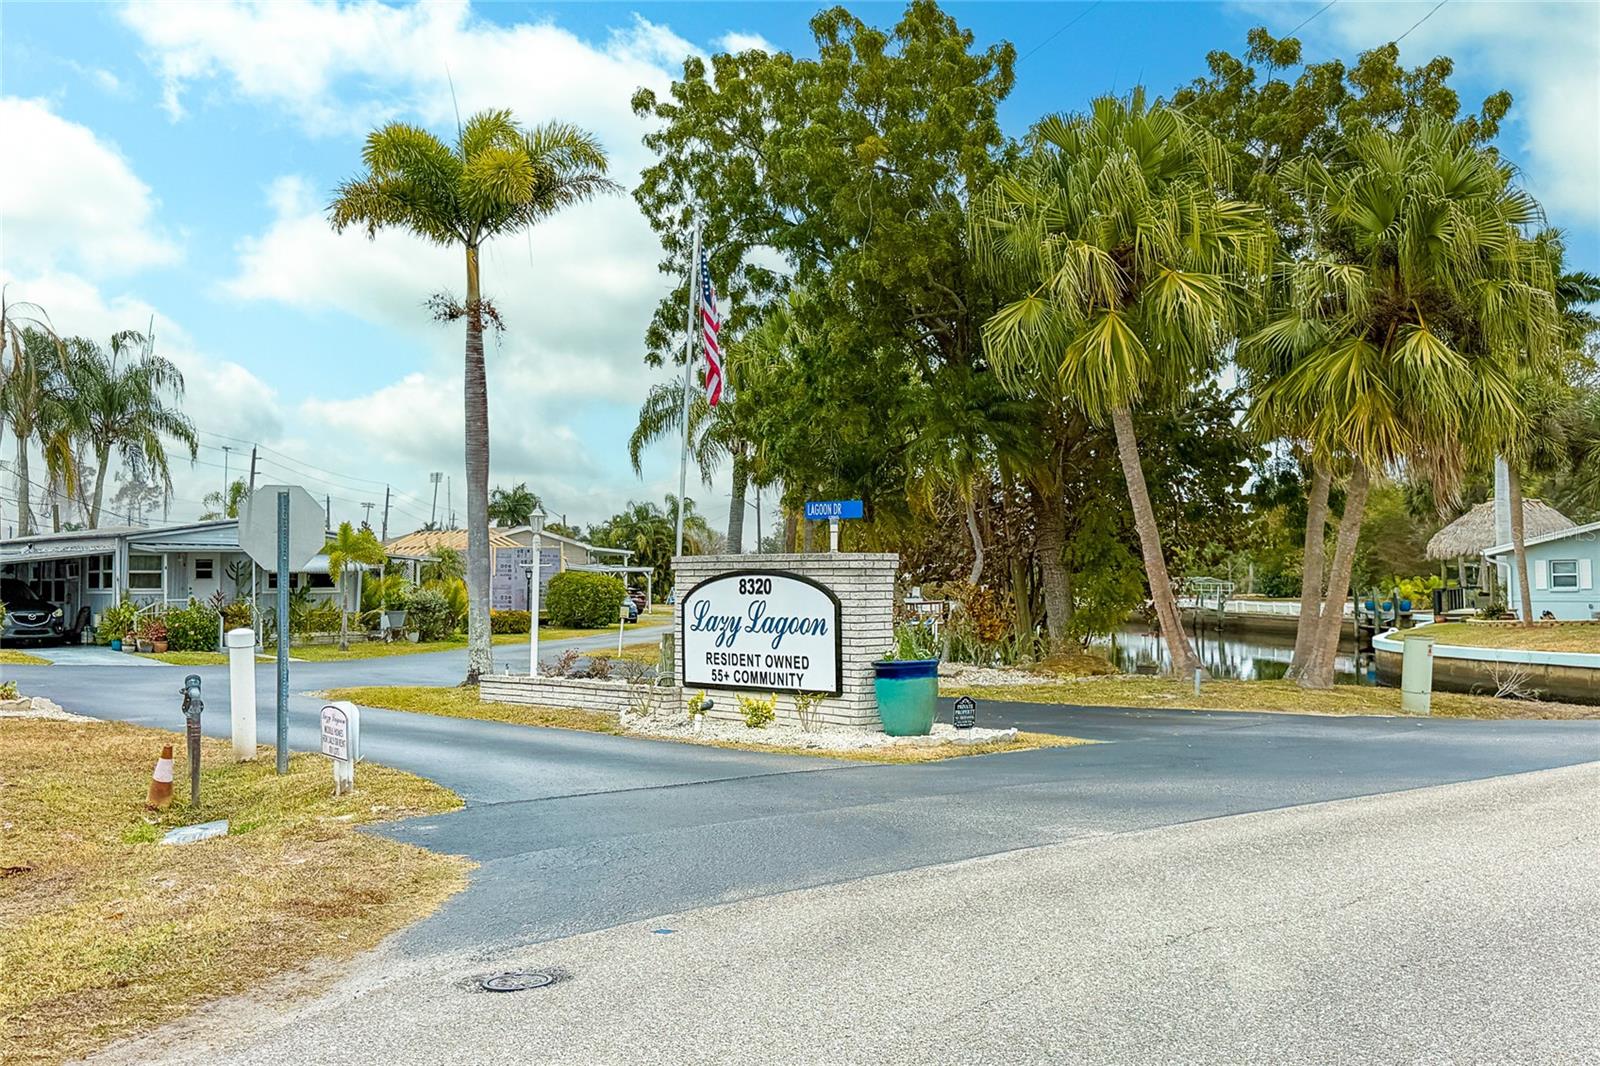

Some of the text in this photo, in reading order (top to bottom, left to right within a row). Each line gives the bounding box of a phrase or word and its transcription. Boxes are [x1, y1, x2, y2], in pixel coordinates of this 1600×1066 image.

[807, 503, 842, 516] LAGOON DR
[738, 578, 773, 595] 8320
[690, 600, 828, 650] Lazy Lagoon
[706, 652, 810, 670] RESIDENT OWNED
[711, 669, 805, 688] 55+ COMMUNITY
